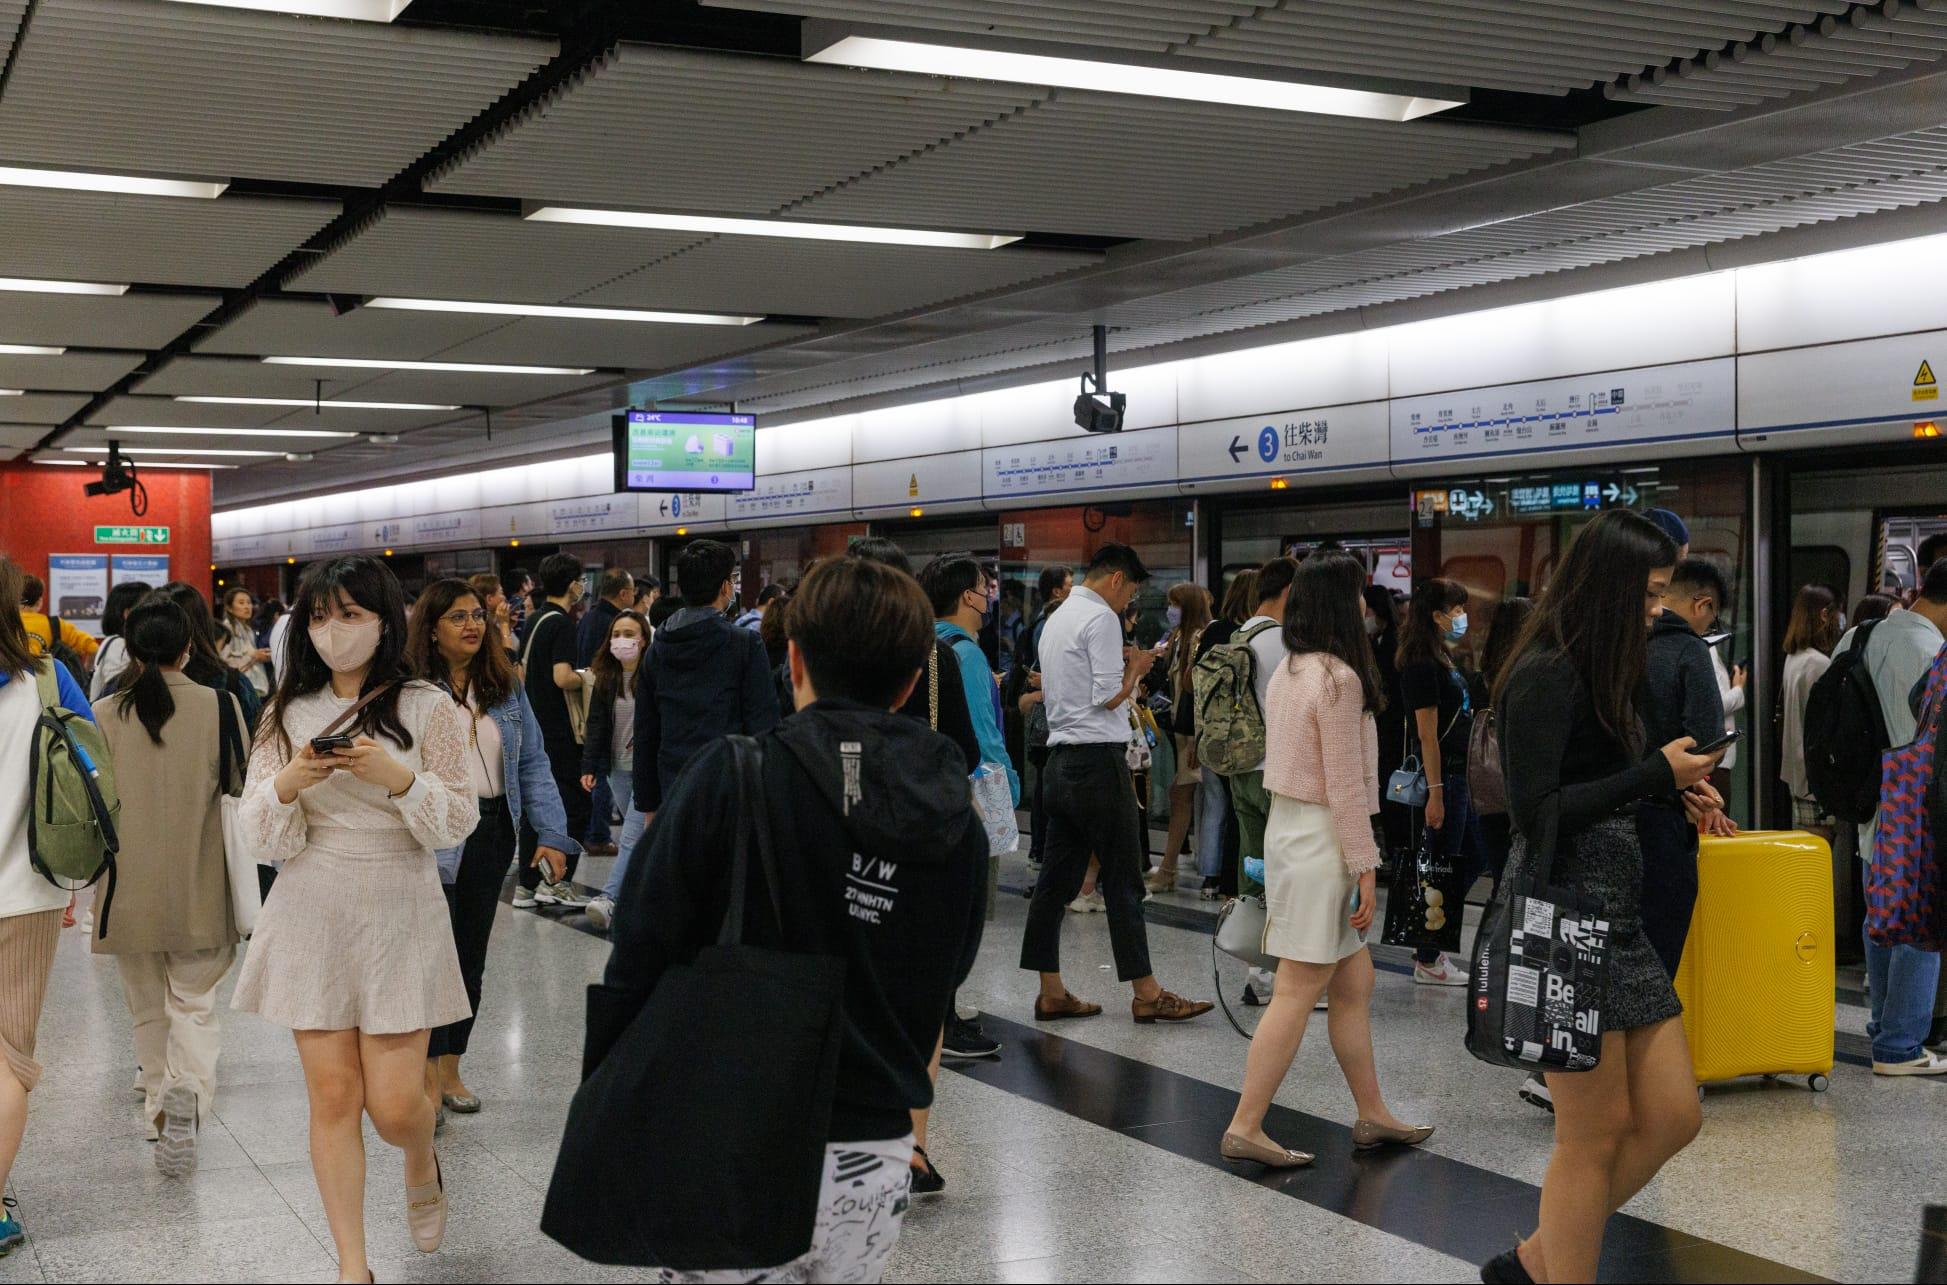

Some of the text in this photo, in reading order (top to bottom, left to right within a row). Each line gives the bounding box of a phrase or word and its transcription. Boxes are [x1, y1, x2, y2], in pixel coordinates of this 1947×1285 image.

[1284, 419, 1328, 448] 往柴灣
[1284, 449, 1323, 463] to Chai Wan
[1546, 974, 1575, 1004] Be
[1575, 1008, 1599, 1036] all
